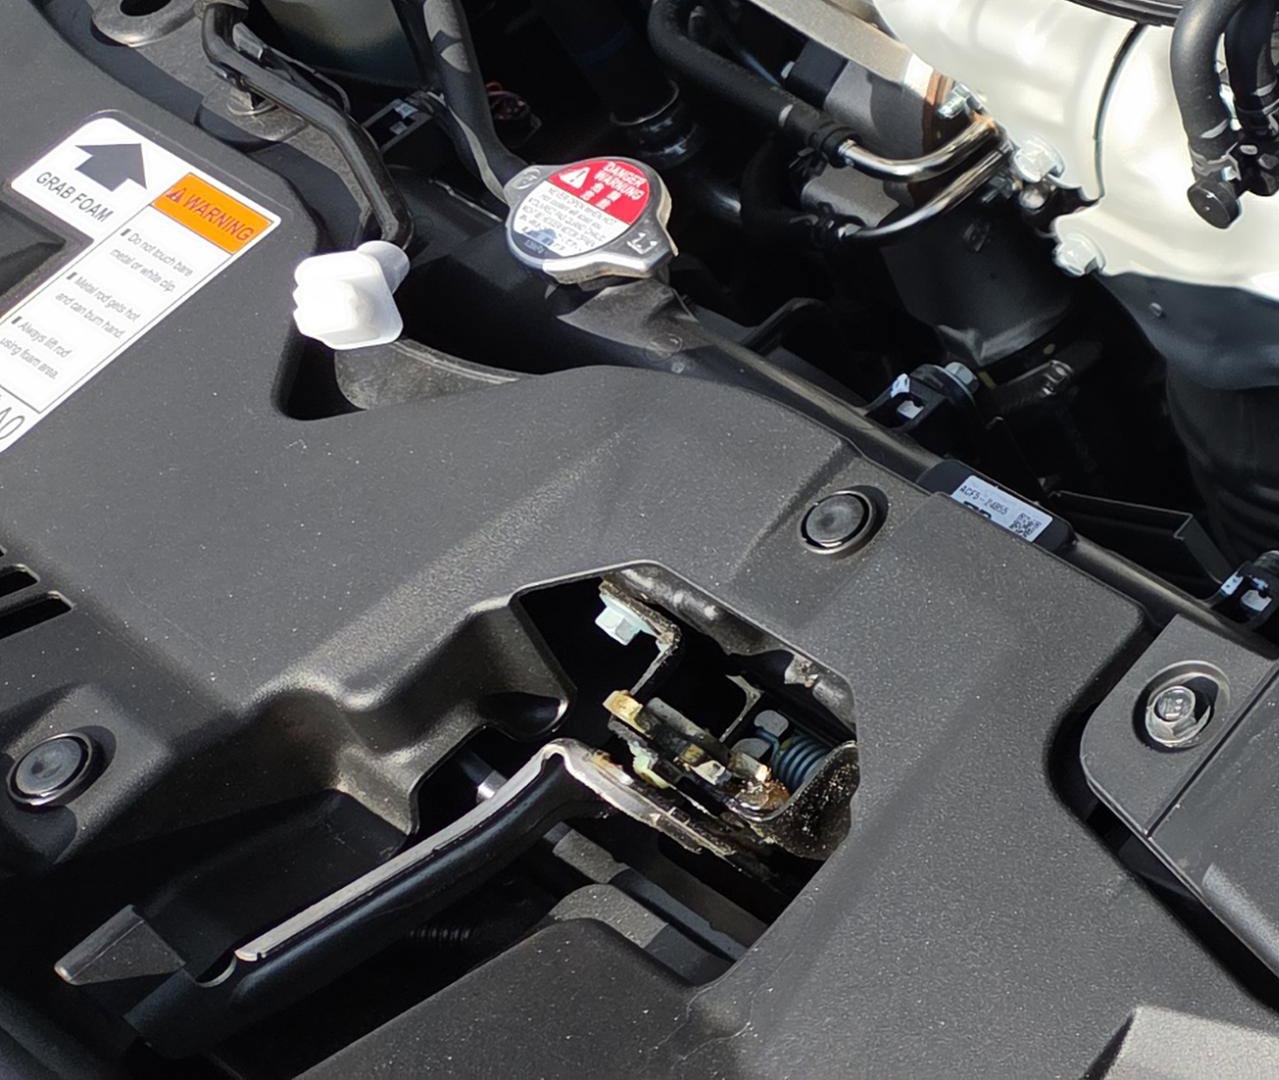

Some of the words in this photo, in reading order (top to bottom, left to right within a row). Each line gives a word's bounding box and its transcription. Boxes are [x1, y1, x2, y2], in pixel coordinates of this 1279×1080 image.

[36, 171, 77, 200] GRAB
[74, 192, 114, 224] FOAM
[181, 193, 255, 242] WARNING
[127, 233, 141, 244] Do
[19, 321, 46, 343] Always
